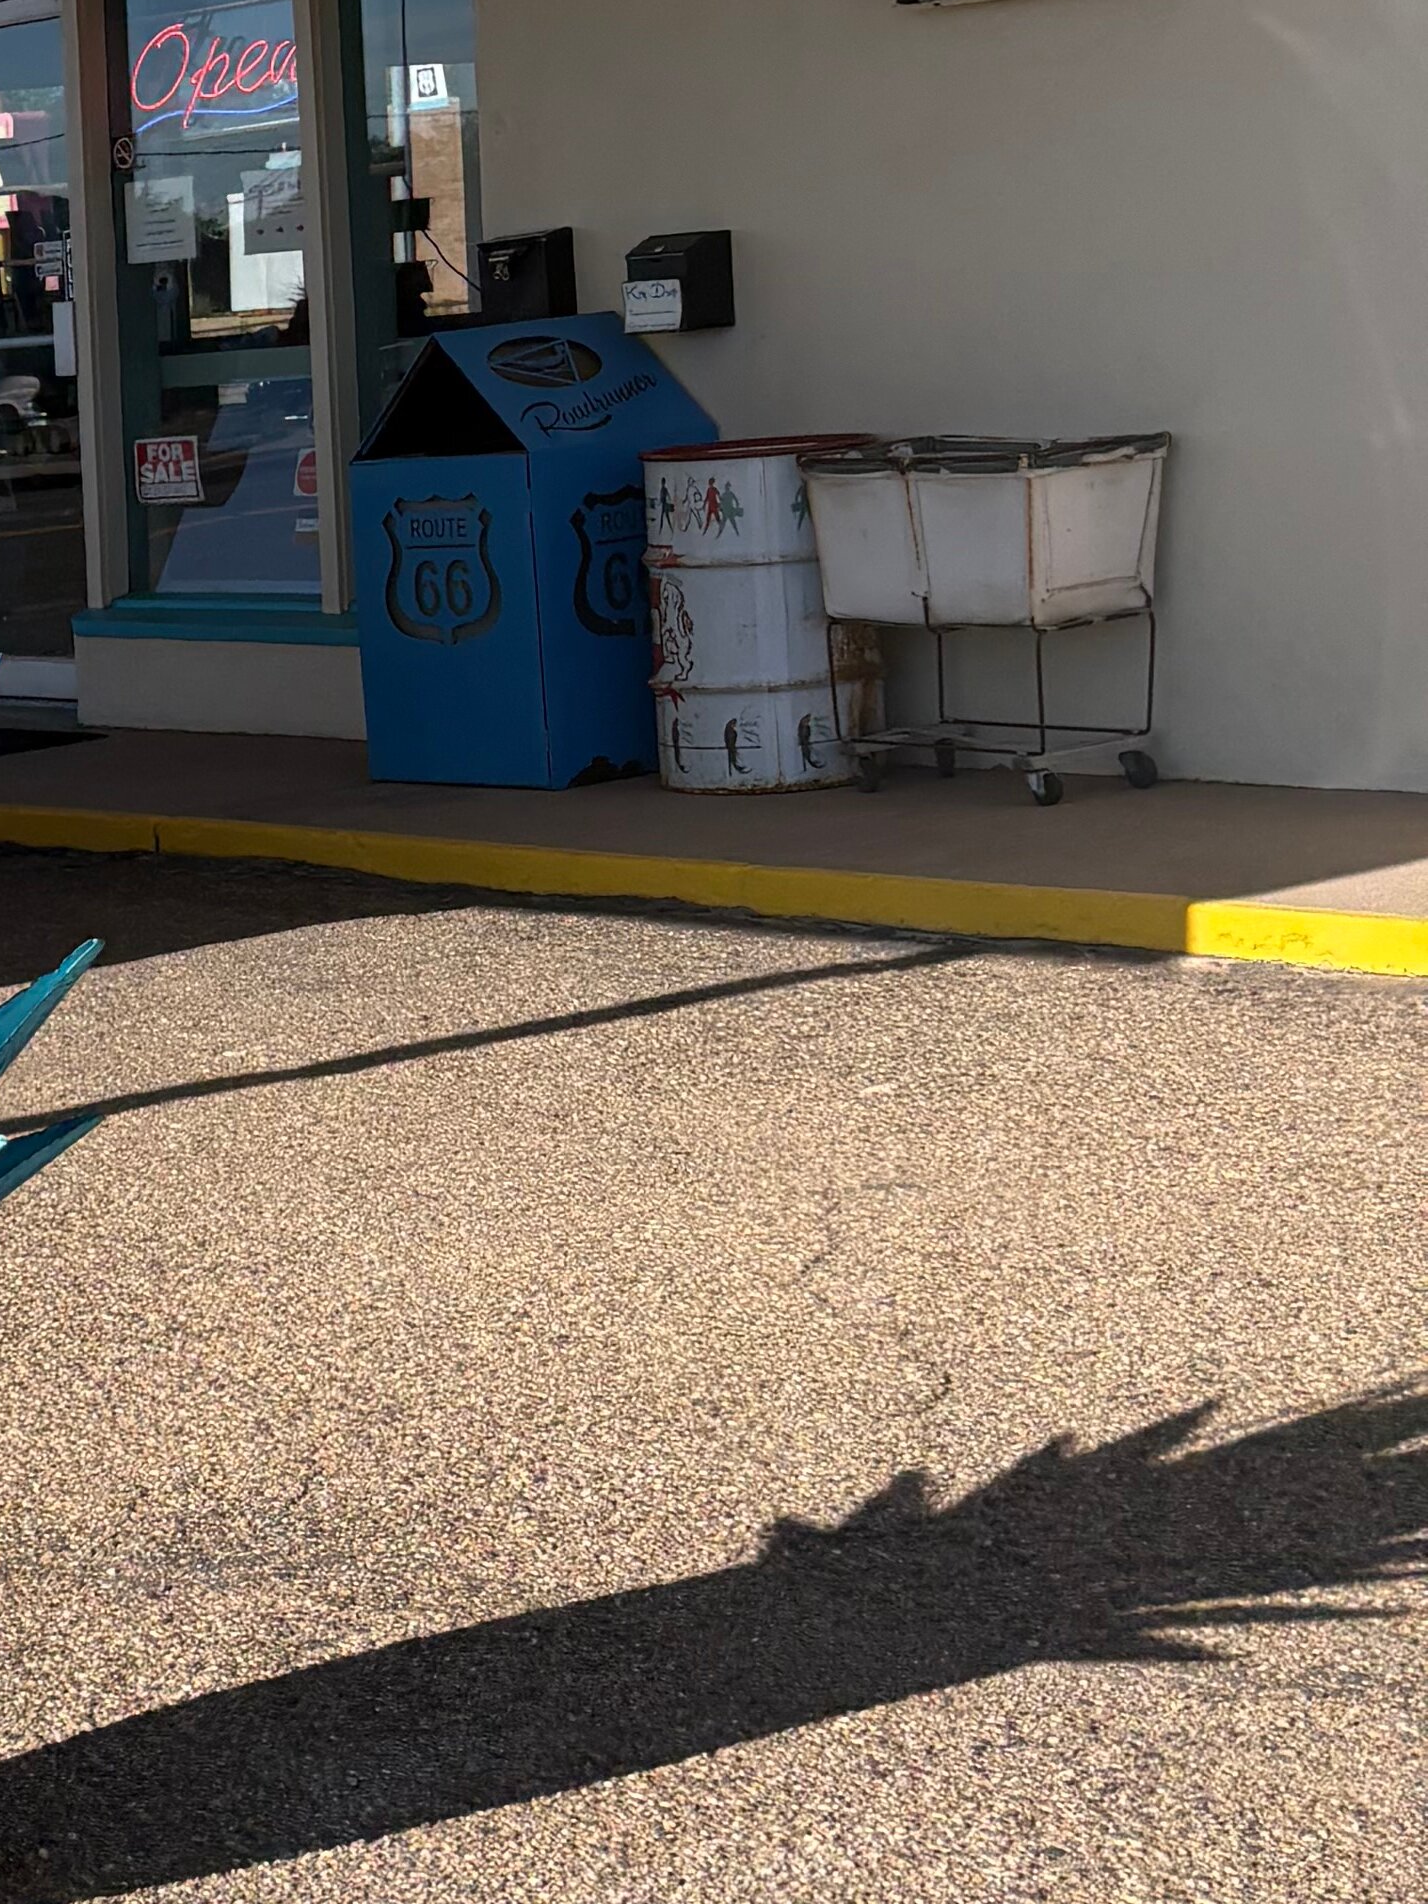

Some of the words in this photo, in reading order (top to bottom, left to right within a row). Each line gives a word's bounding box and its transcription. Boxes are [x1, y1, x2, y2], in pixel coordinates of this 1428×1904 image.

[147, 443, 183, 463] FOR
[140, 460, 197, 484] SALE
[410, 517, 468, 539] ROUTE
[414, 559, 473, 617] 66
